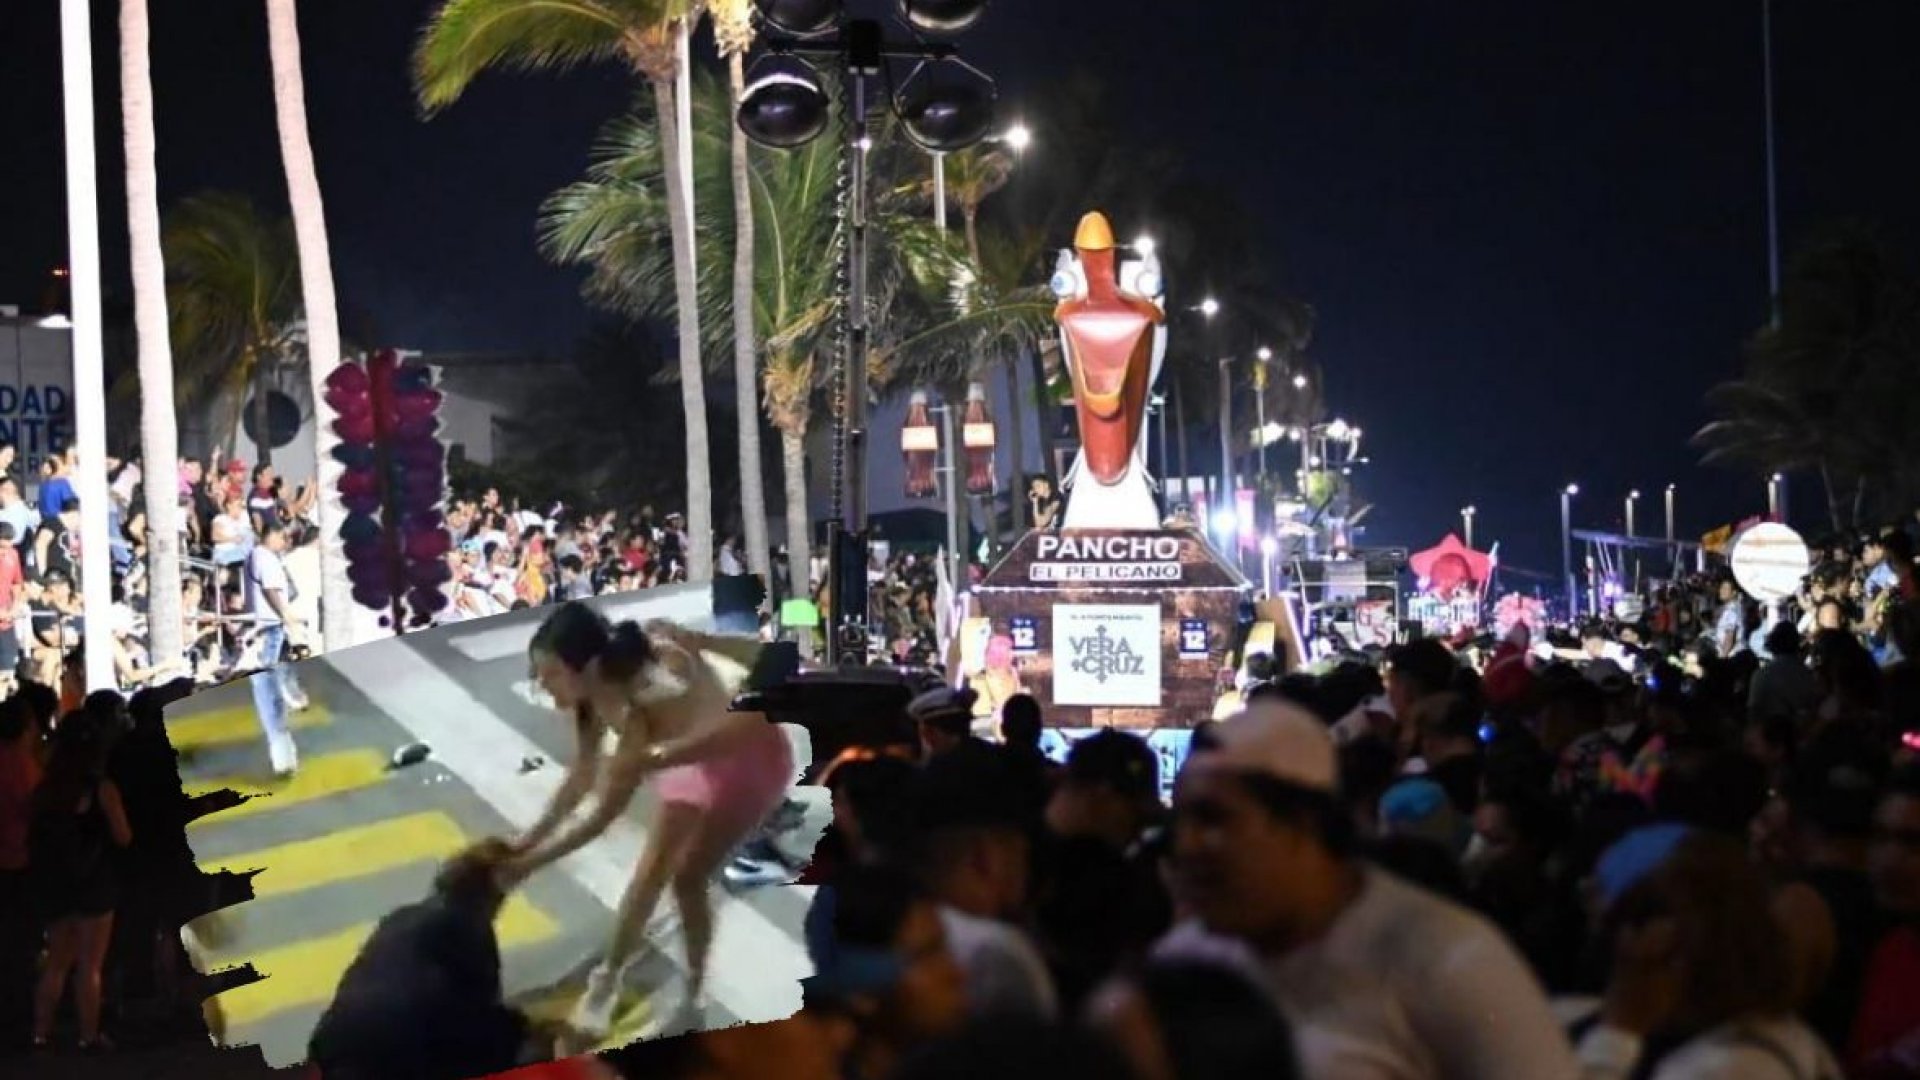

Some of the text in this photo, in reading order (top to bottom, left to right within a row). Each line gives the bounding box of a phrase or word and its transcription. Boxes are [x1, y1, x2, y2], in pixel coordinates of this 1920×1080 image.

[1037, 535, 1179, 560] PANCHO
[1032, 565, 1179, 578] EL PELICANO
[1069, 636, 1132, 655] VERA
[1082, 655, 1144, 675] CRUZ
